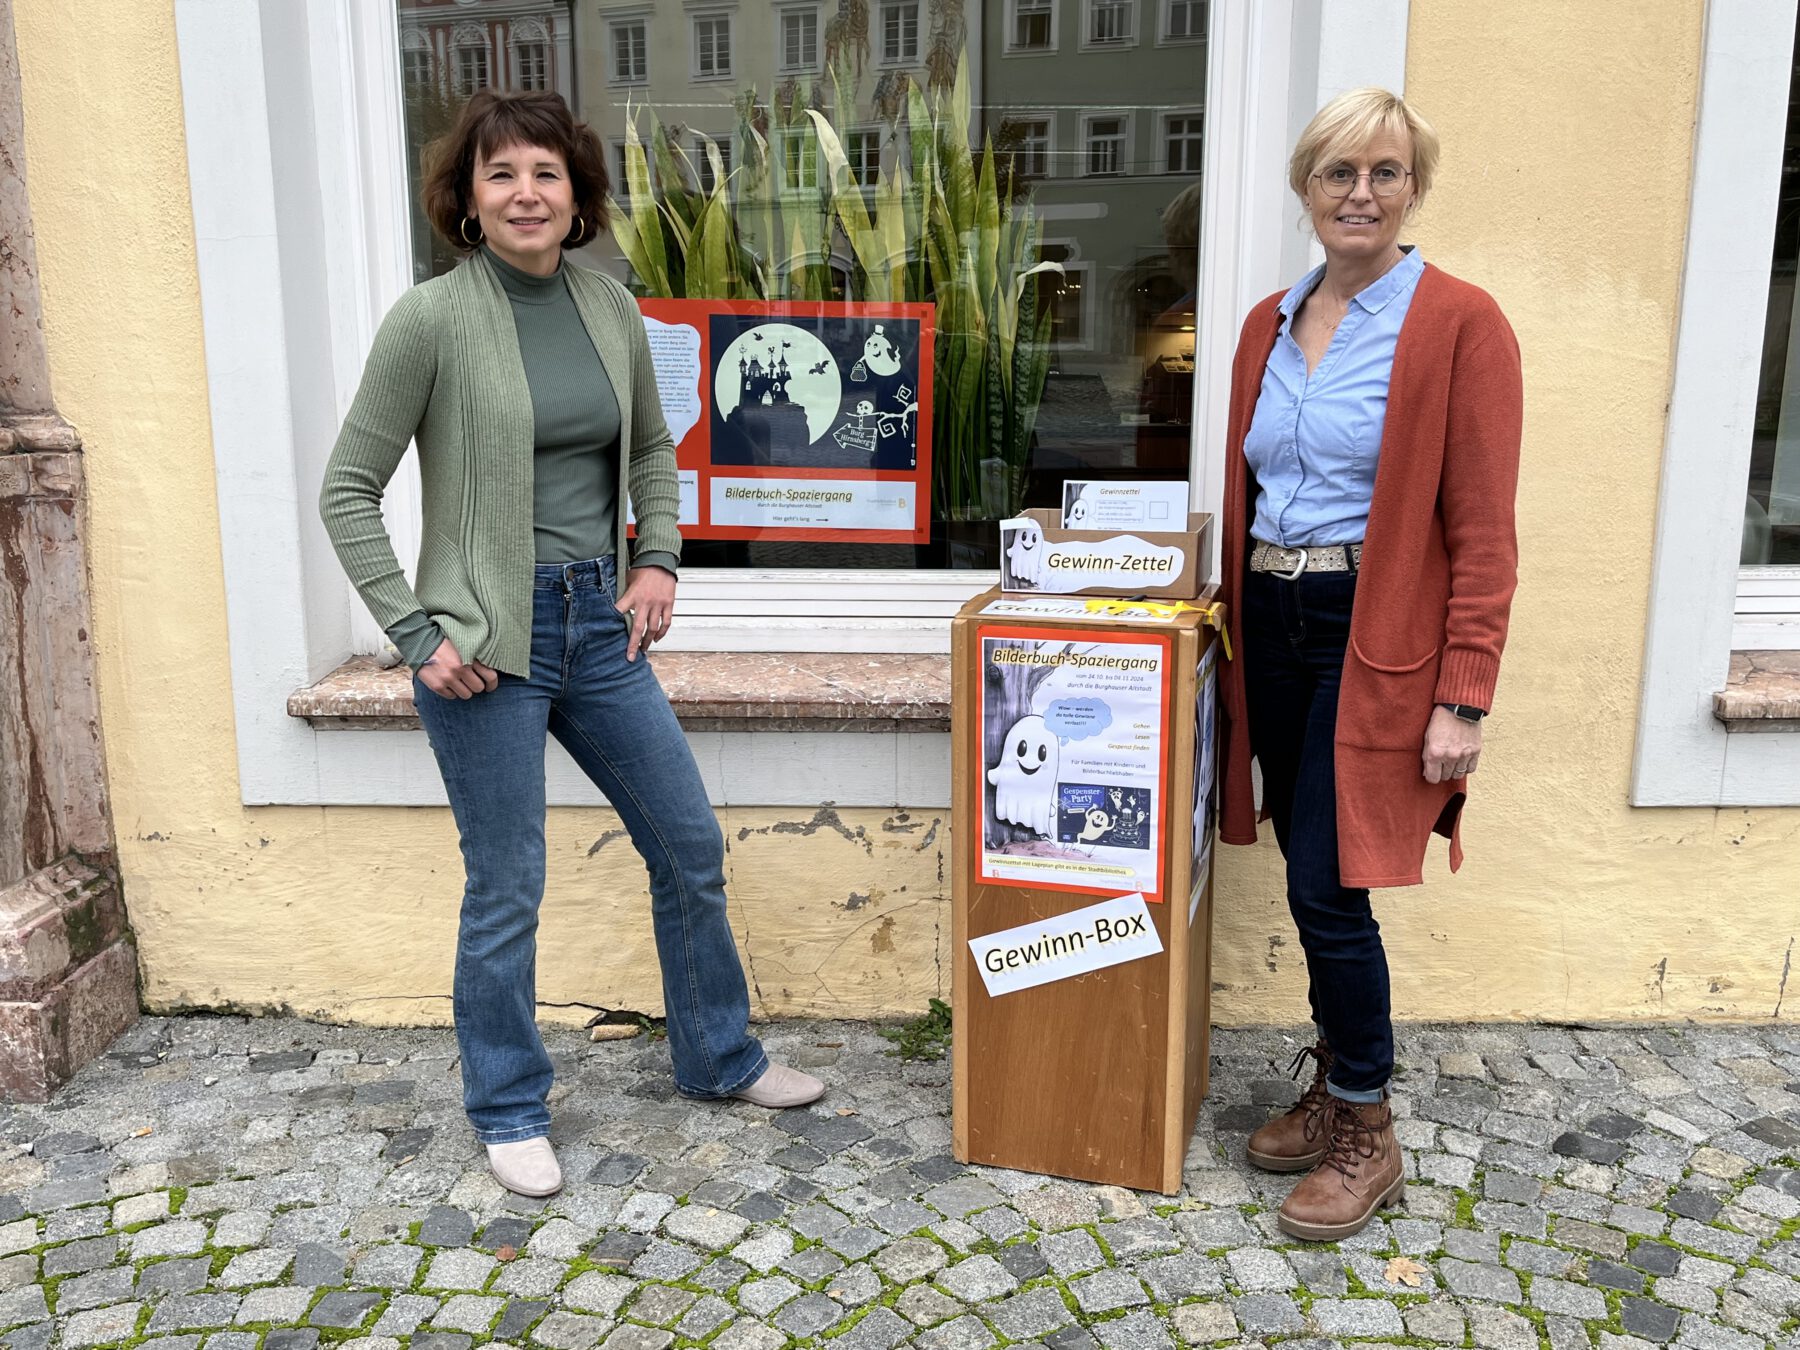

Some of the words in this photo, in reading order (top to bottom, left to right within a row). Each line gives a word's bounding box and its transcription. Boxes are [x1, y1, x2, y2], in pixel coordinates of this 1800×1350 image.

[841, 434, 870, 447] Hirnsberg
[850, 430, 865, 438] Burg
[726, 488, 852, 502] Bilderbuch-Spaziergang
[1048, 553, 1174, 571] Gewinn-Zettel
[994, 650, 1158, 671] Bilderbuch-Spaziergang
[1064, 788, 1102, 796] Gespenster-
[1072, 794, 1092, 803] Party
[985, 914, 1146, 972] Gewinn-Box
